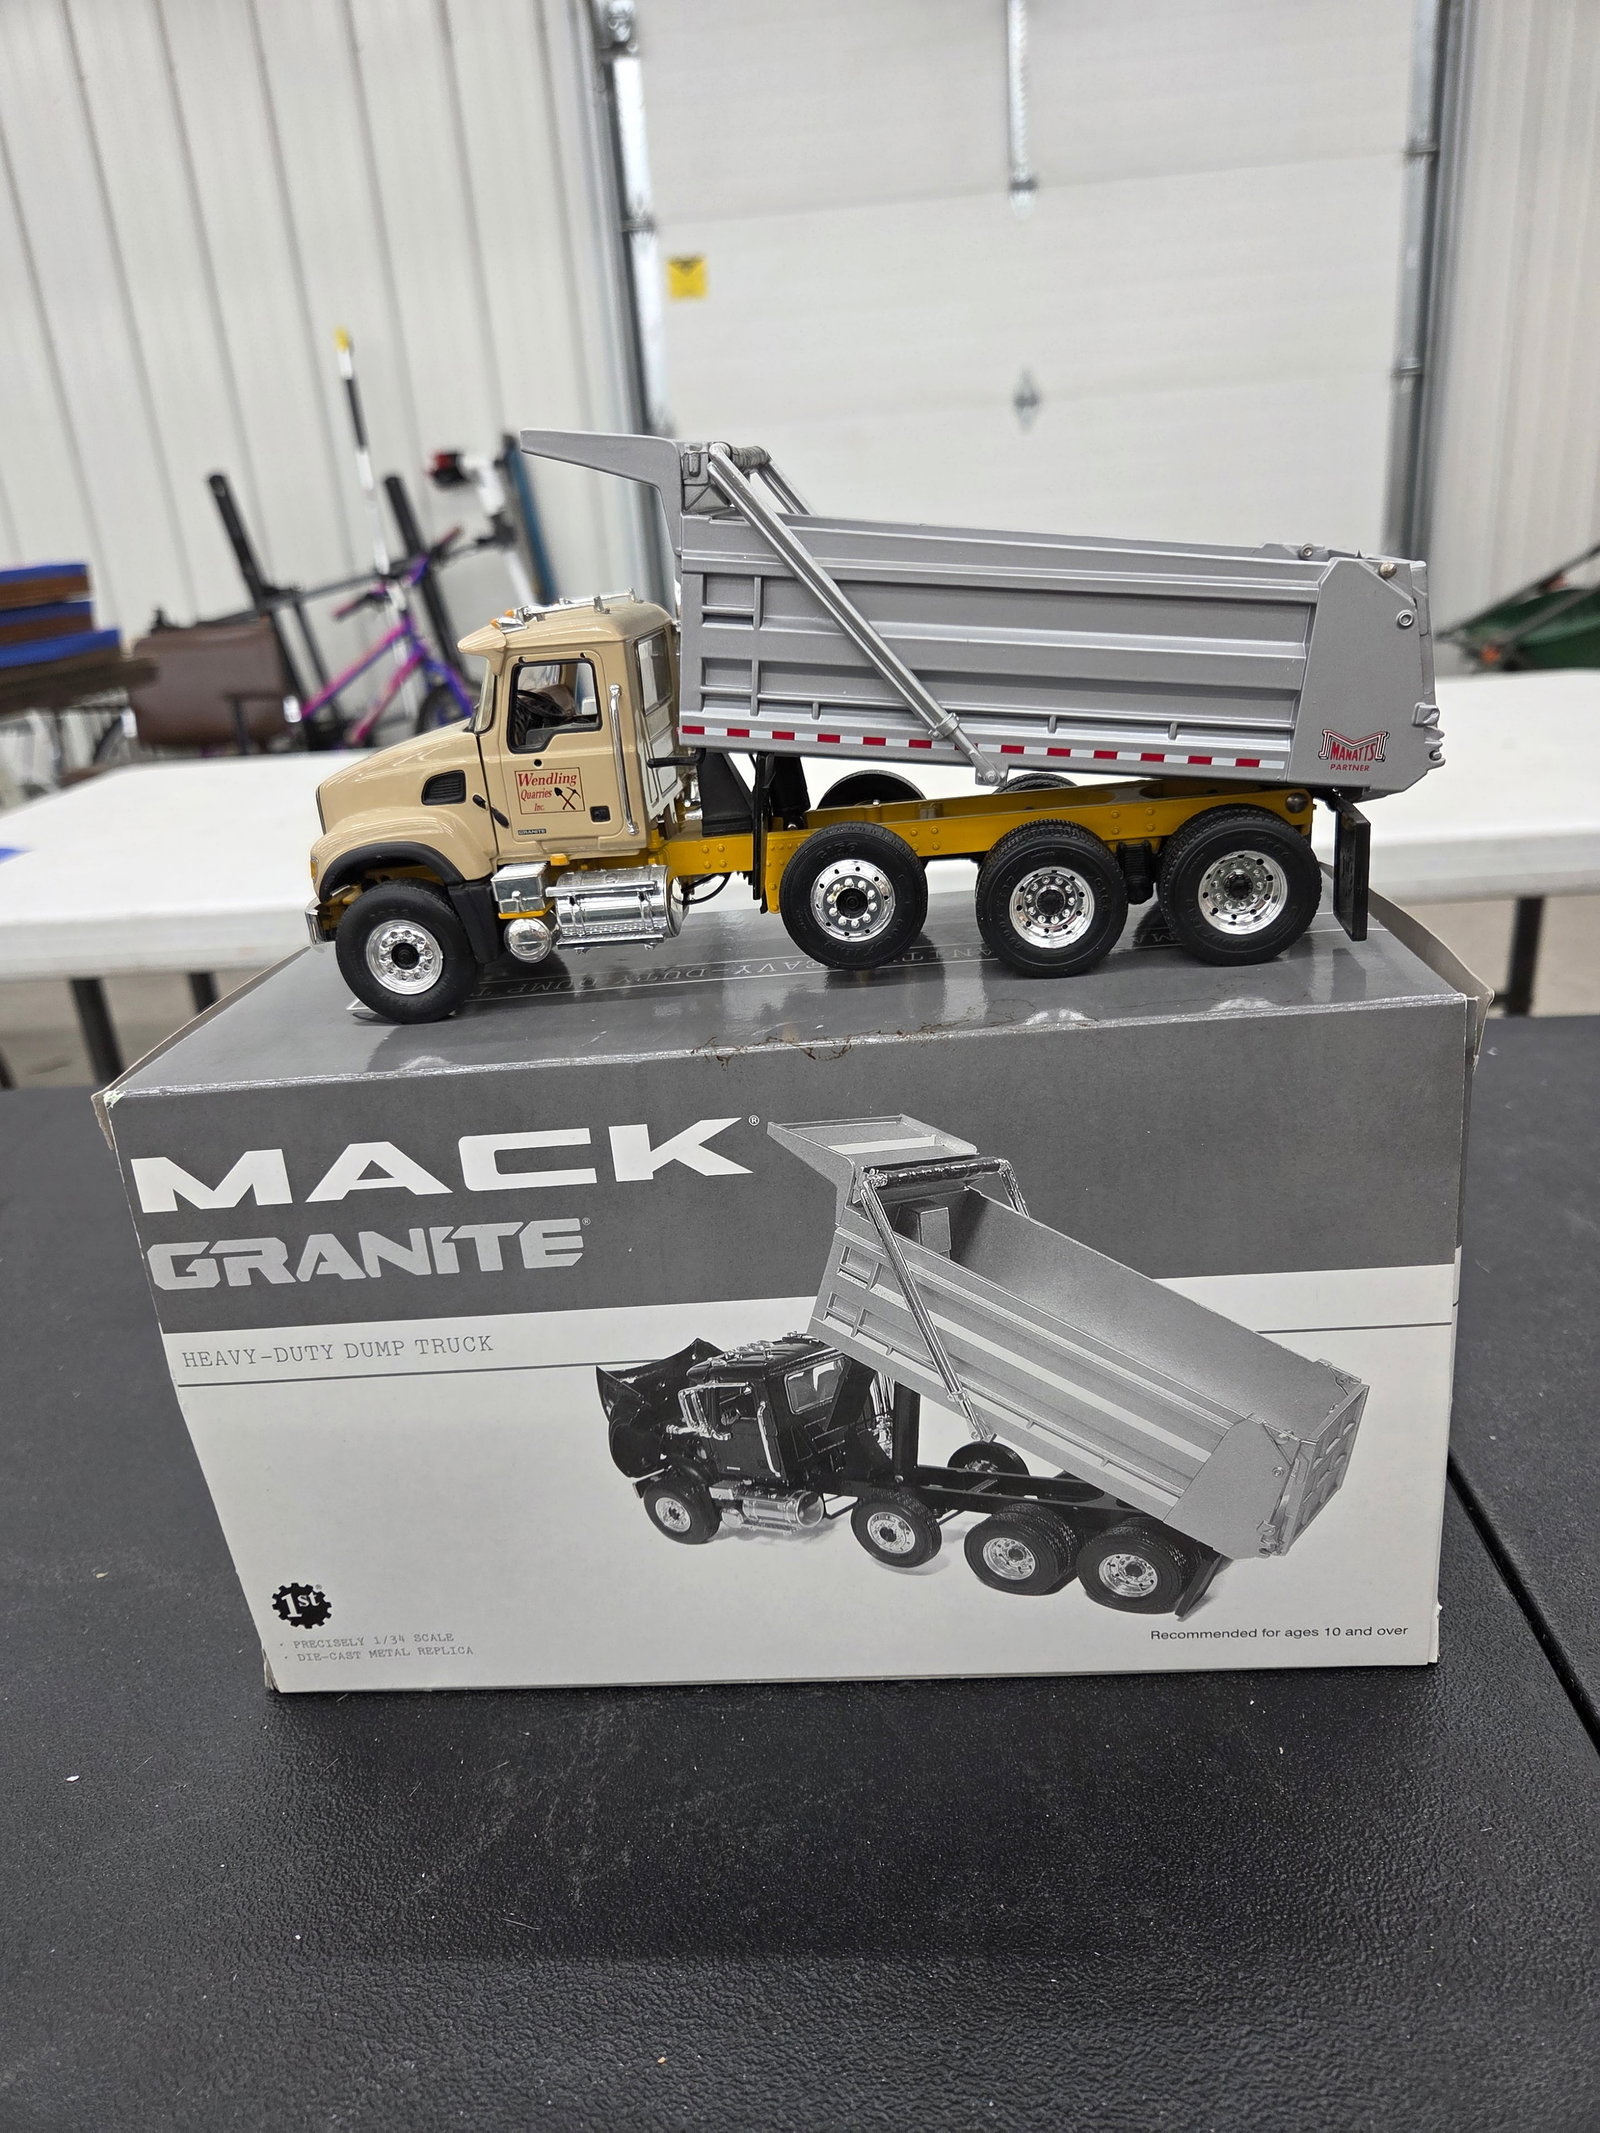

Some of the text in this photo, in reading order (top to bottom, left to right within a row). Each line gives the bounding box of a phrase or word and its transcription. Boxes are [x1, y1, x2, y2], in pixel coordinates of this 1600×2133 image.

[1330, 763, 1370, 772] PARTNER
[517, 772, 577, 787] Wendling
[520, 788, 552, 801] Quarries
[182, 1335, 494, 1368] HEAVY-DUTY DUMP TRUCK
[293, 1633, 455, 1649] PRECISELY 1/34 SCALE
[1150, 1626, 1409, 1641] Recommended for ages 10 and over
[297, 1646, 474, 1662] DIE-CAST METAL REPLICA
